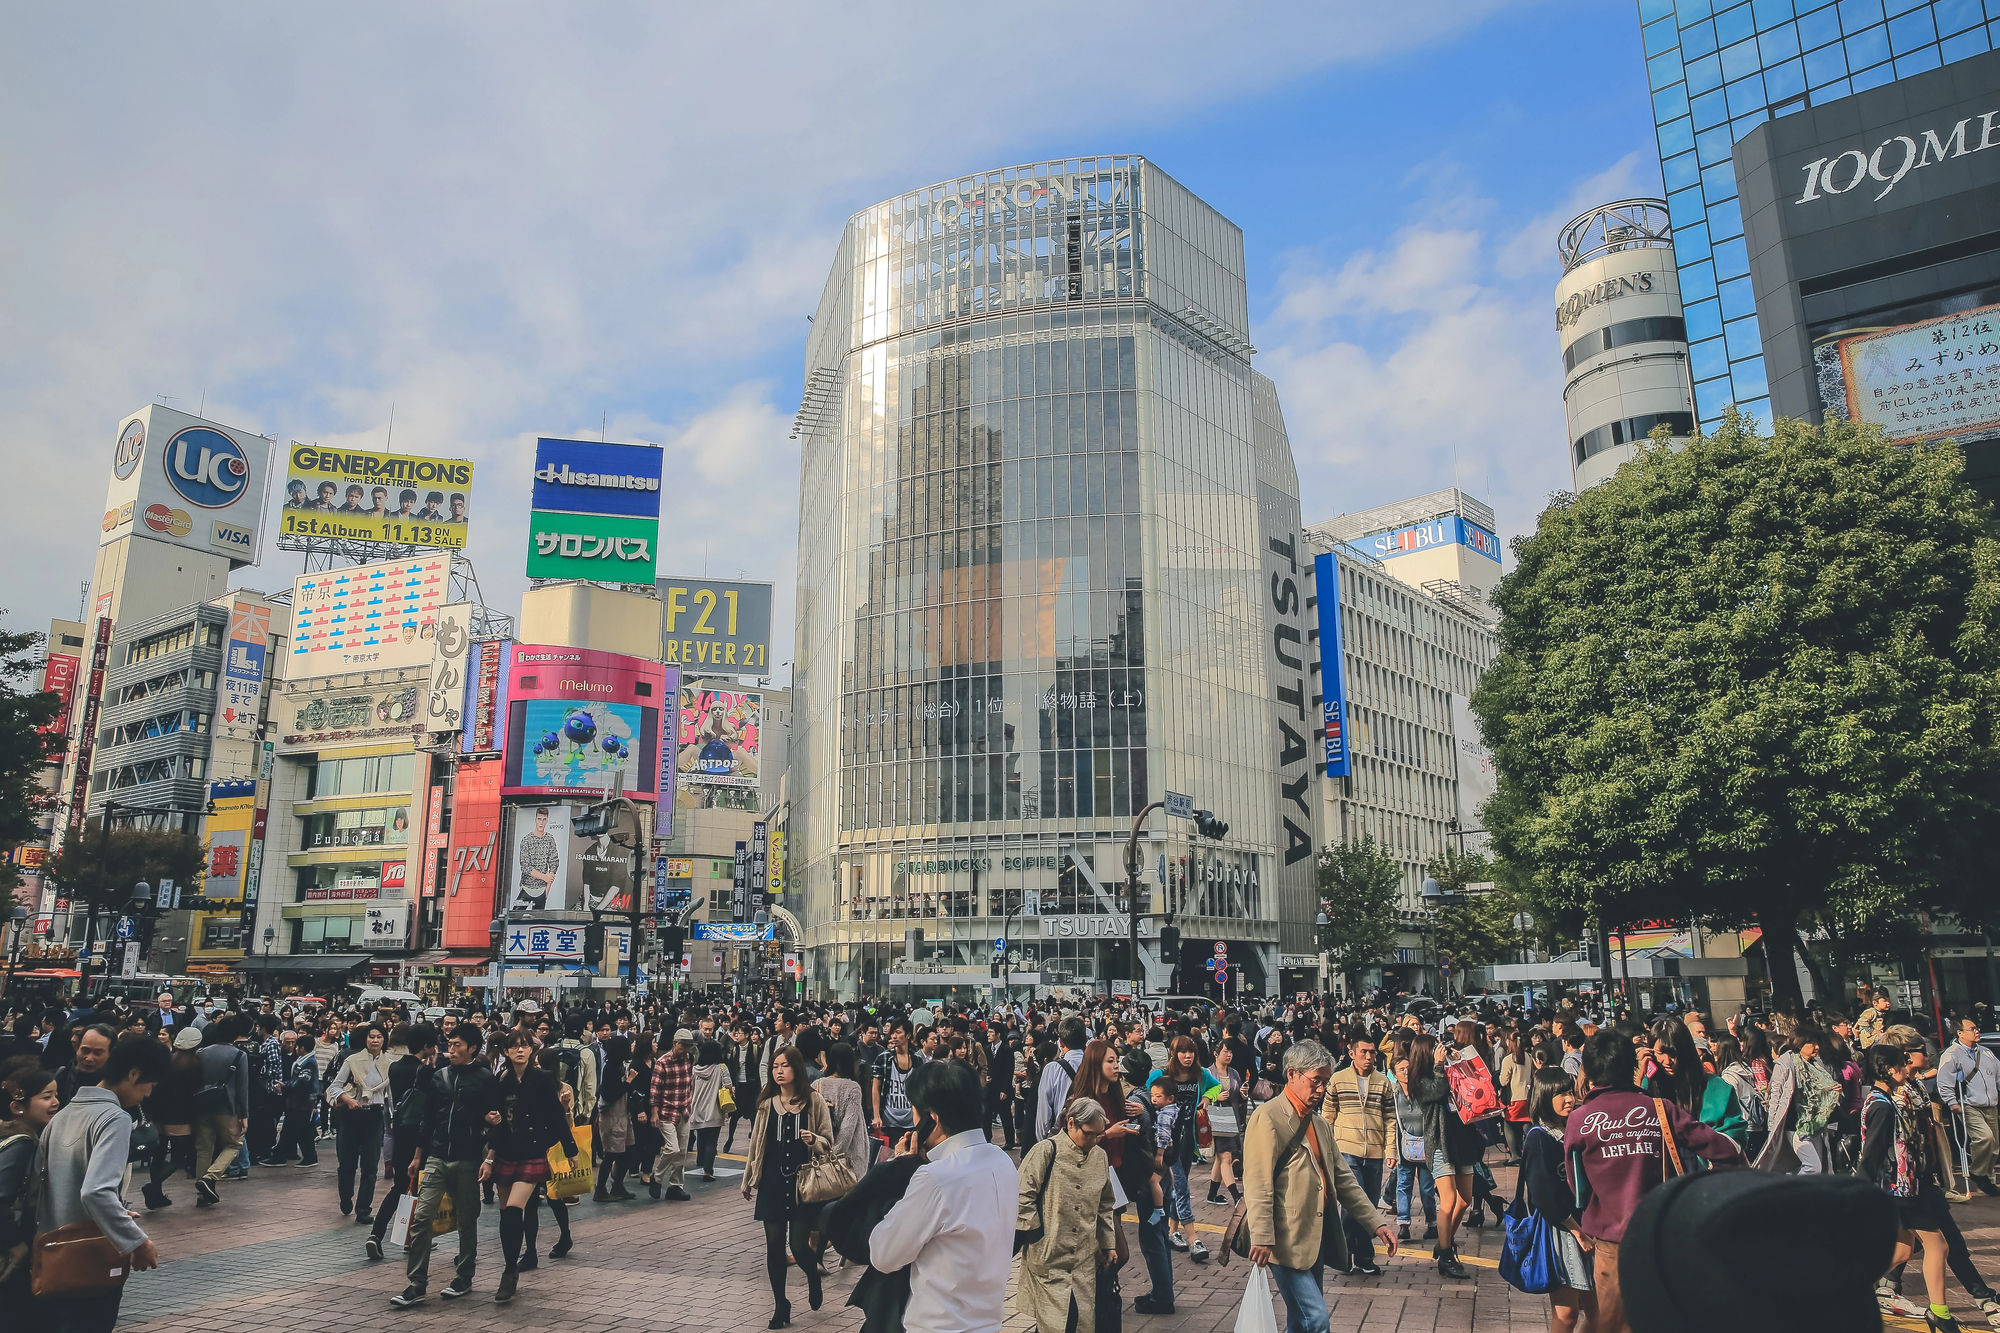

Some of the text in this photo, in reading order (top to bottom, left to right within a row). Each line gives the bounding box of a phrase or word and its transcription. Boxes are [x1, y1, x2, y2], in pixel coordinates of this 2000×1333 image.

[1931, 321, 1994, 345] 第12位
[174, 439, 248, 492] UC
[293, 447, 470, 485] GENERATIONS
[344, 475, 418, 489] from EXILE TRIBE
[535, 463, 659, 490] Hisamitsu
[145, 511, 192, 530] MasterCard
[286, 515, 433, 543] 1st Album 11.13
[217, 527, 250, 547] VISA
[434, 527, 450, 537] ON
[434, 536, 462, 546] SALE
[1374, 523, 1445, 559] SEIBU
[535, 531, 651, 562] サロンパス
[1463, 523, 1499, 560] SEIBU
[301, 587, 331, 602] 帝京
[666, 587, 738, 636] F21
[230, 648, 238, 665] BOOK
[352, 653, 380, 663] 帝京大学
[525, 653, 551, 662] わかさ生活
[743, 645, 766, 666] 21
[428, 615, 468, 728] もんじゃ
[226, 680, 259, 695] 夜11時
[230, 694, 252, 706] まで
[695, 691, 748, 713] LADY
[1268, 531, 1312, 866] TSUTAYA
[238, 712, 256, 724] 地下
[660, 686, 677, 793] Taisei neon
[1323, 701, 1342, 763] SEIBU
[689, 759, 739, 771] ARTPOP
[314, 832, 380, 846] Euphoria
[210, 845, 238, 876] 薬
[575, 853, 628, 864] ISABEL MARANT
[753, 825, 766, 888] 洋服の青山
[897, 856, 1066, 874] STARBUCKS COFFEE
[383, 865, 405, 882] JTB
[1199, 865, 1258, 886] TSUTAYA
[734, 849, 745, 917] 洋服の青山
[331, 890, 351, 898] 海外旅行
[372, 920, 395, 934] 松川
[1044, 918, 1148, 936] TSUTAYA
[1626, 1129, 1661, 1140] anytime
[1601, 1142, 1653, 1158] LEFLAH
[554, 1169, 585, 1180] FOREVER
